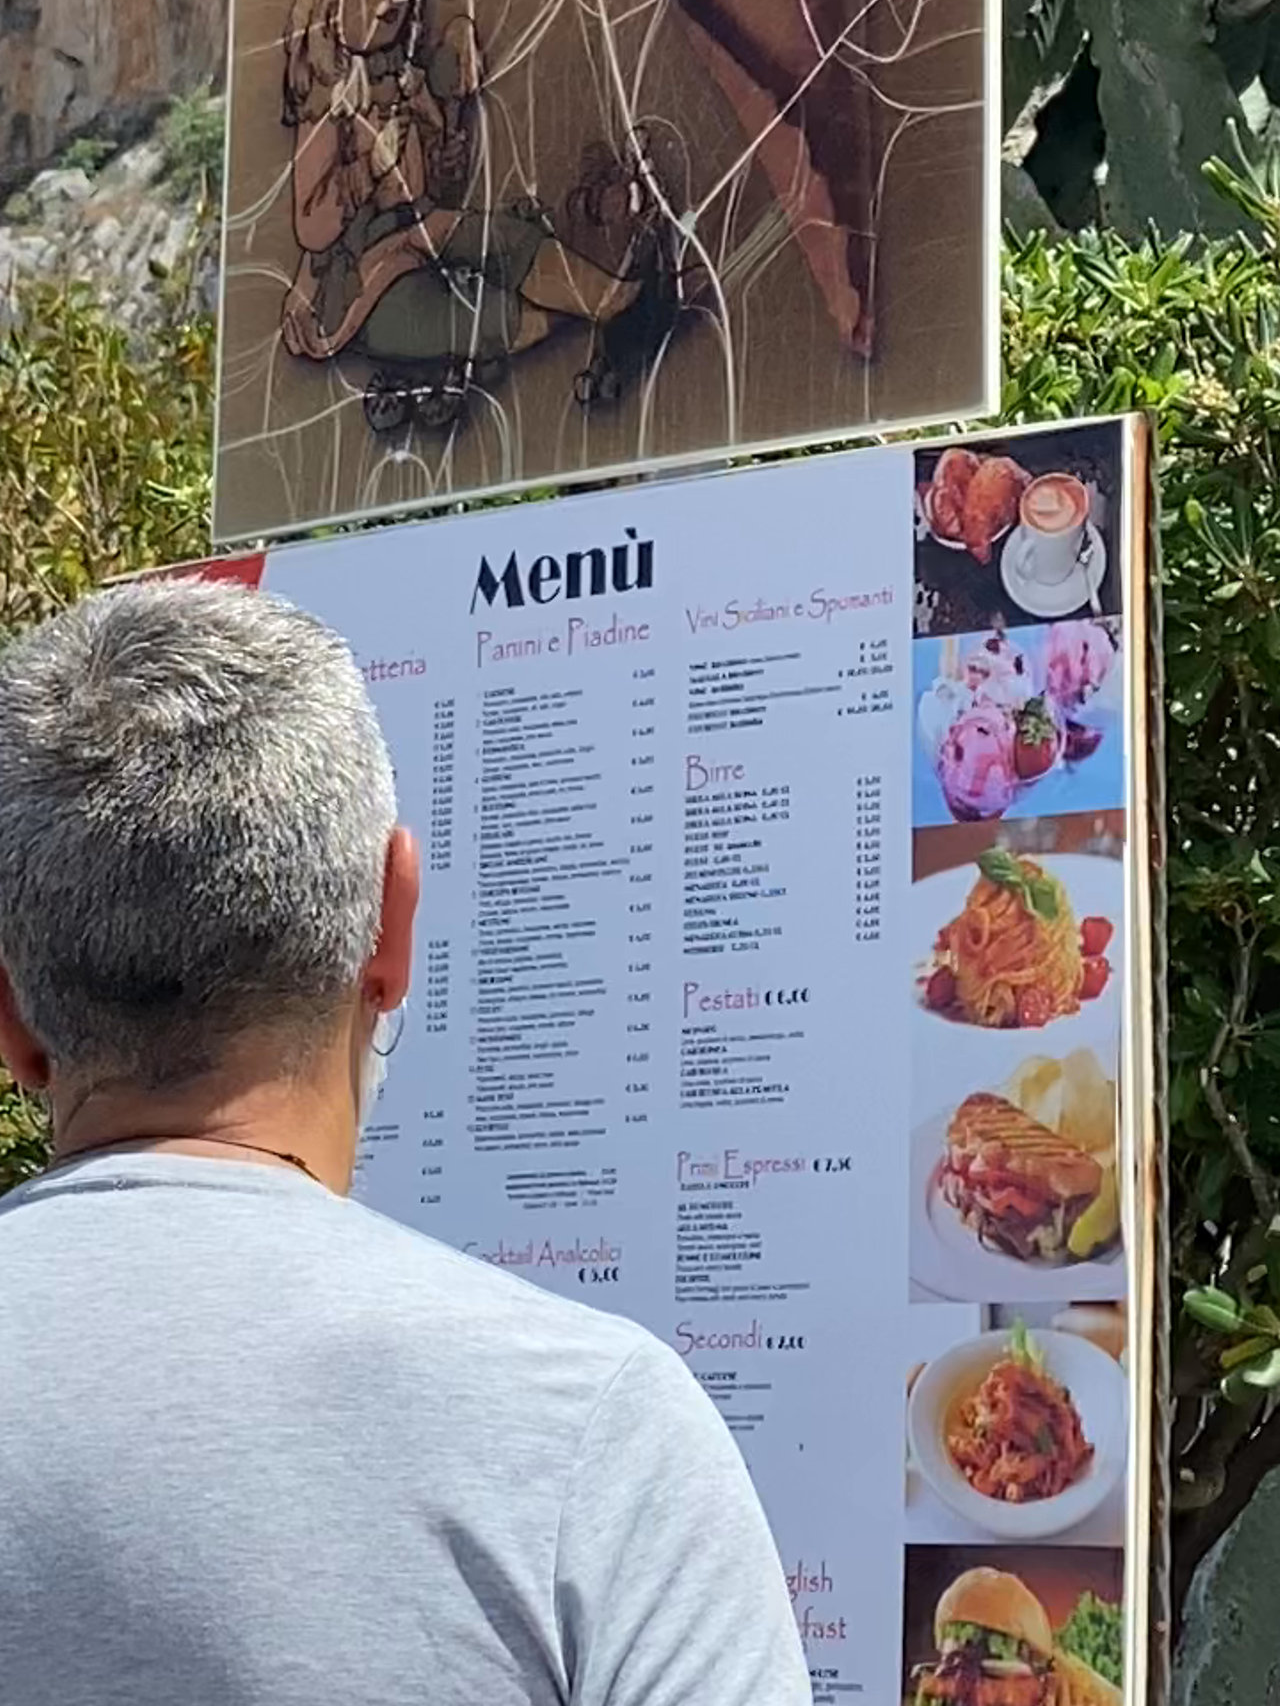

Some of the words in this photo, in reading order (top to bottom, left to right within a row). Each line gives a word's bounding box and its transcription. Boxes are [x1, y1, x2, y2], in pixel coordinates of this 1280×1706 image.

[470, 527, 655, 615] Menù
[477, 630, 542, 668] Panini
[548, 634, 561, 653] e
[568, 612, 651, 656] Piadine
[686, 754, 745, 791] Birre
[724, 1149, 806, 1187] Espressi
[676, 1319, 762, 1356] Secondi
[786, 1560, 834, 1603] glish
